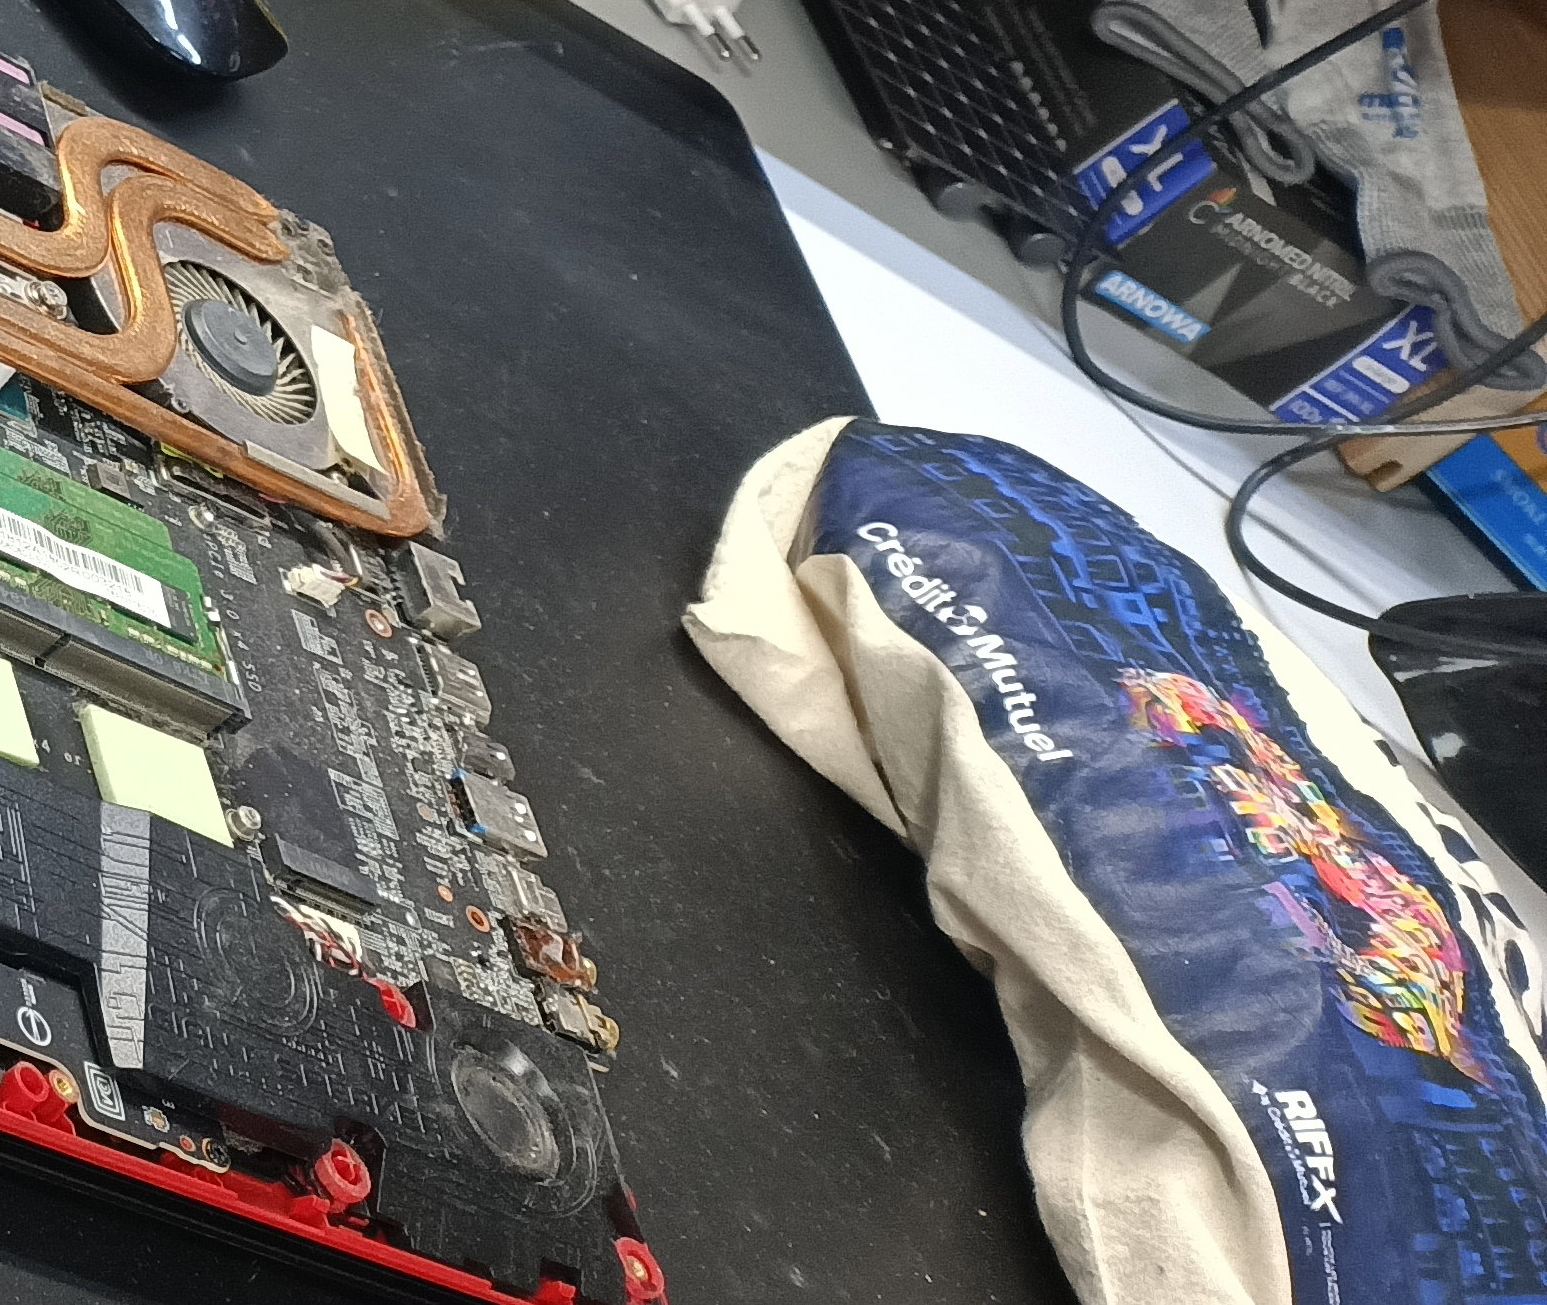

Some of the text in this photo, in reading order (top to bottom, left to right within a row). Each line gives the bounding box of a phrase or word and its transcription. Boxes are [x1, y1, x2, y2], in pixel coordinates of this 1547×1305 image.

[1096, 267, 1205, 343] ARNOWA
[1382, 320, 1439, 370] XL
[856, 520, 1073, 765] Crédit Mutuel
[1274, 1088, 1343, 1227] RIFFX
